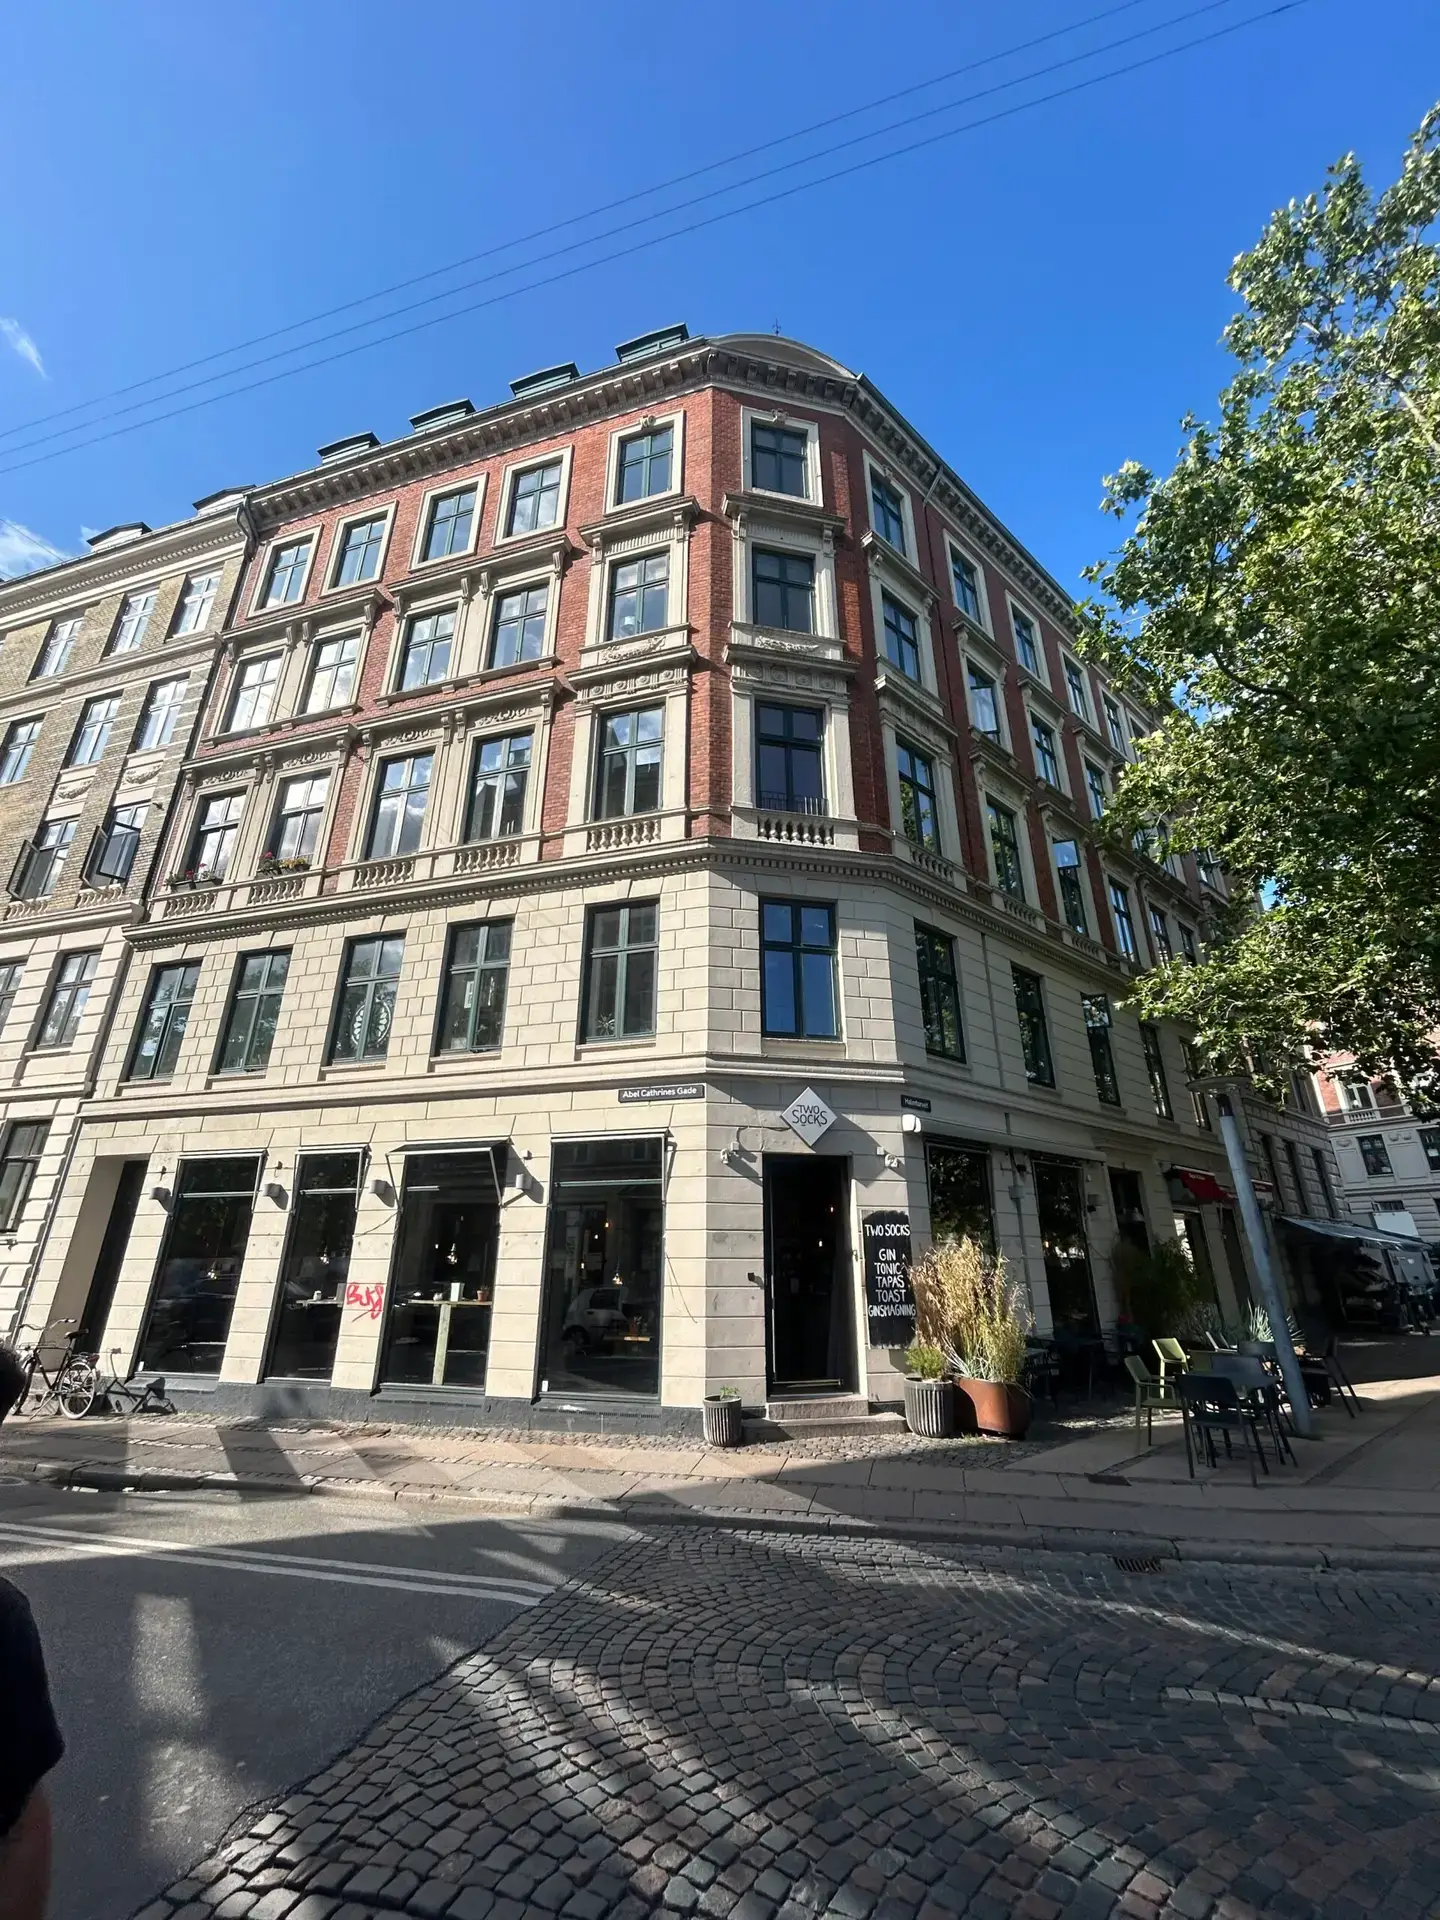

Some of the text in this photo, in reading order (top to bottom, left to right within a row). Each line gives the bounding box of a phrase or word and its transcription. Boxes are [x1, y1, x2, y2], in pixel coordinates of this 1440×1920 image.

[622, 1086, 697, 1098] Abel Cathrines Gade
[795, 1104, 820, 1114] TWO
[791, 1109, 828, 1127] SOCKS
[864, 1224, 911, 1236] TWO SOCKS
[878, 1248, 896, 1261] GIN
[874, 1262, 902, 1275] TONIC
[875, 1275, 905, 1288] TAPAS
[875, 1289, 906, 1303] TOAST
[868, 1304, 916, 1317] GINSMAGNING
